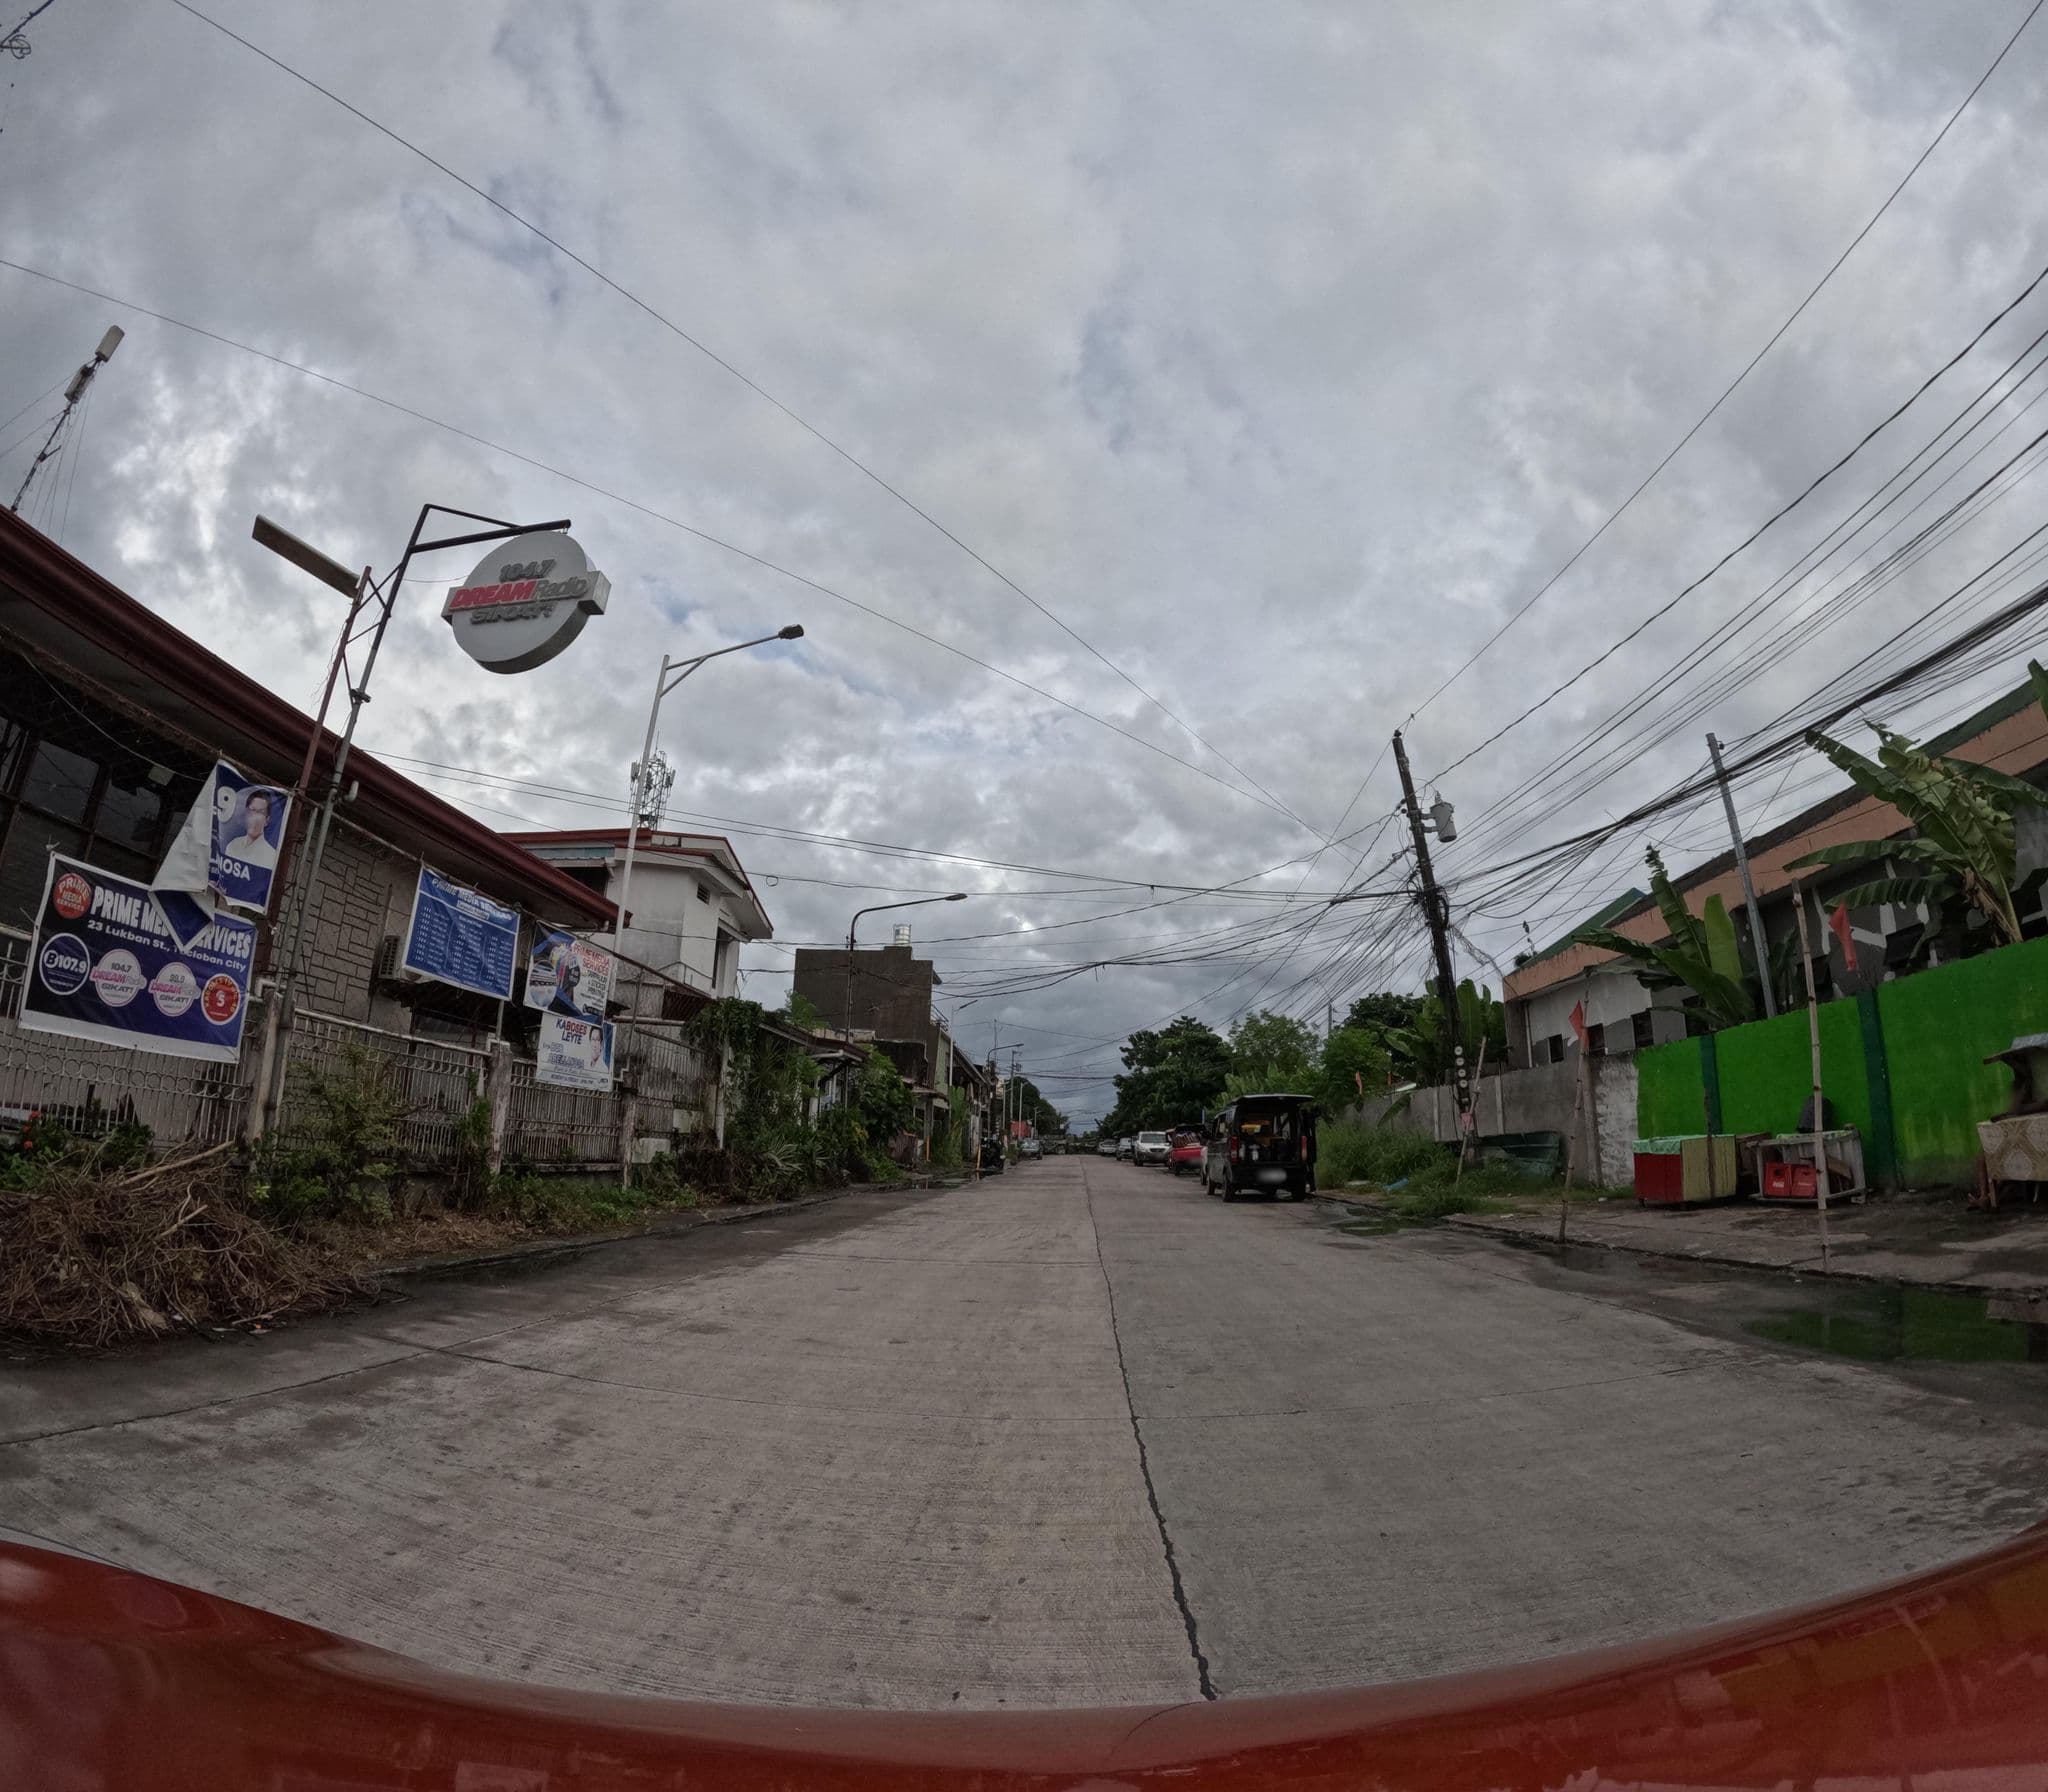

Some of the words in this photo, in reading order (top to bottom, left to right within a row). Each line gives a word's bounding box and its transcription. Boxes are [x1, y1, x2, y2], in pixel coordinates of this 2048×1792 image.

[499, 559, 555, 583] 104.7
[449, 580, 537, 608] DREAM
[58, 877, 90, 901] PRIME
[432, 878, 458, 896] PRIME
[90, 885, 142, 928] PRIME
[87, 919, 104, 931] 23
[105, 925, 151, 945] Lukban
[225, 958, 246, 973] City
[57, 954, 87, 974] 107.9
[556, 1017, 587, 1035] KABOSES
[562, 1030, 583, 1045] LEYTE
